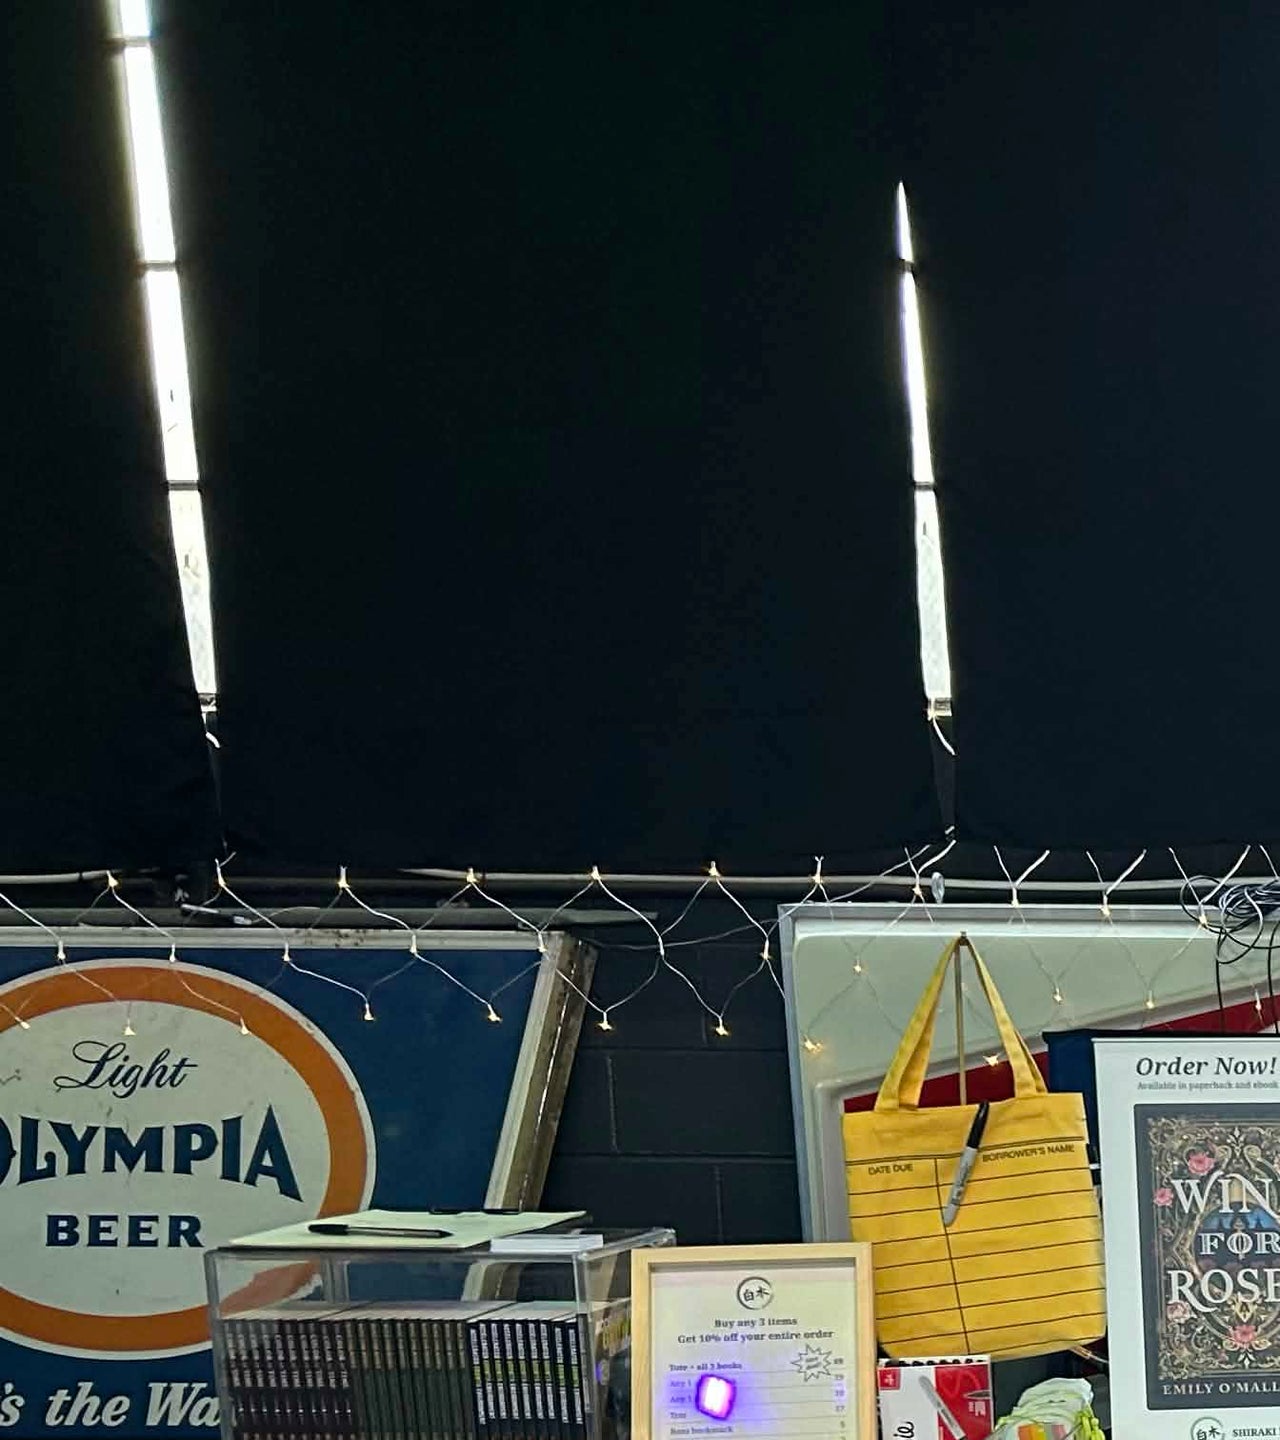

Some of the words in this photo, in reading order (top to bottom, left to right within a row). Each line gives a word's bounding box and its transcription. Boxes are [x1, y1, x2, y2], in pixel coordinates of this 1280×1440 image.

[53, 1040, 198, 1099] Light
[1135, 1056, 1209, 1076] Order
[1215, 1056, 1277, 1076] Now!
[982, 1147, 1046, 1163] BORROWER'S
[1047, 1144, 1076, 1154] NAME
[868, 1165, 891, 1176] DATE
[893, 1163, 914, 1174] DUE
[46, 1214, 205, 1247] BEER
[742, 1286, 770, 1302] 白木
[715, 1318, 734, 1328] Buy
[737, 1319, 755, 1328] any
[759, 1318, 765, 1326] 3
[767, 1317, 798, 1326] items
[678, 1335, 696, 1344] Get
[700, 1334, 721, 1343] 10%
[723, 1332, 738, 1342] off
[740, 1333, 767, 1344] your
[768, 1332, 801, 1340] entire
[803, 1330, 834, 1339] order
[1162, 1383, 1214, 1395] EMILY
[45, 1381, 131, 1427] the
[145, 1382, 222, 1427] Wa
[1196, 1425, 1221, 1440] 白木
[1232, 1427, 1277, 1438] SHIRAKI
